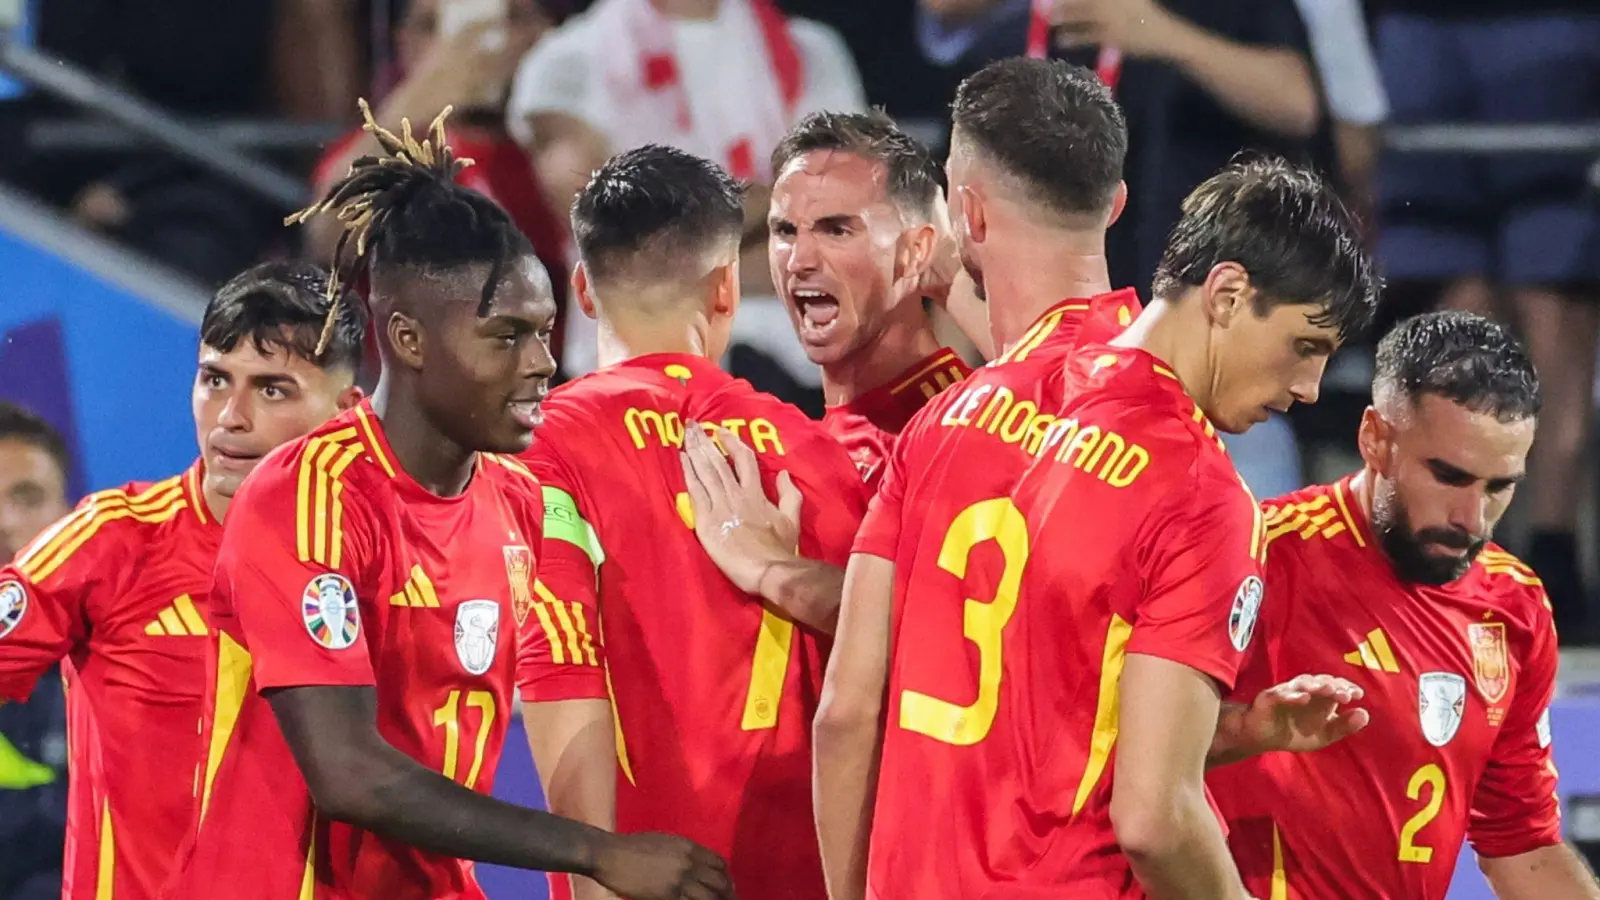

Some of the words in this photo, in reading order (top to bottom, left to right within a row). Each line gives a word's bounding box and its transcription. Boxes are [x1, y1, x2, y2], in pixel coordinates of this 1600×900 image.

[899, 496, 1030, 746] 3
[433, 690, 496, 790] 17
[1398, 763, 1447, 864] 2
